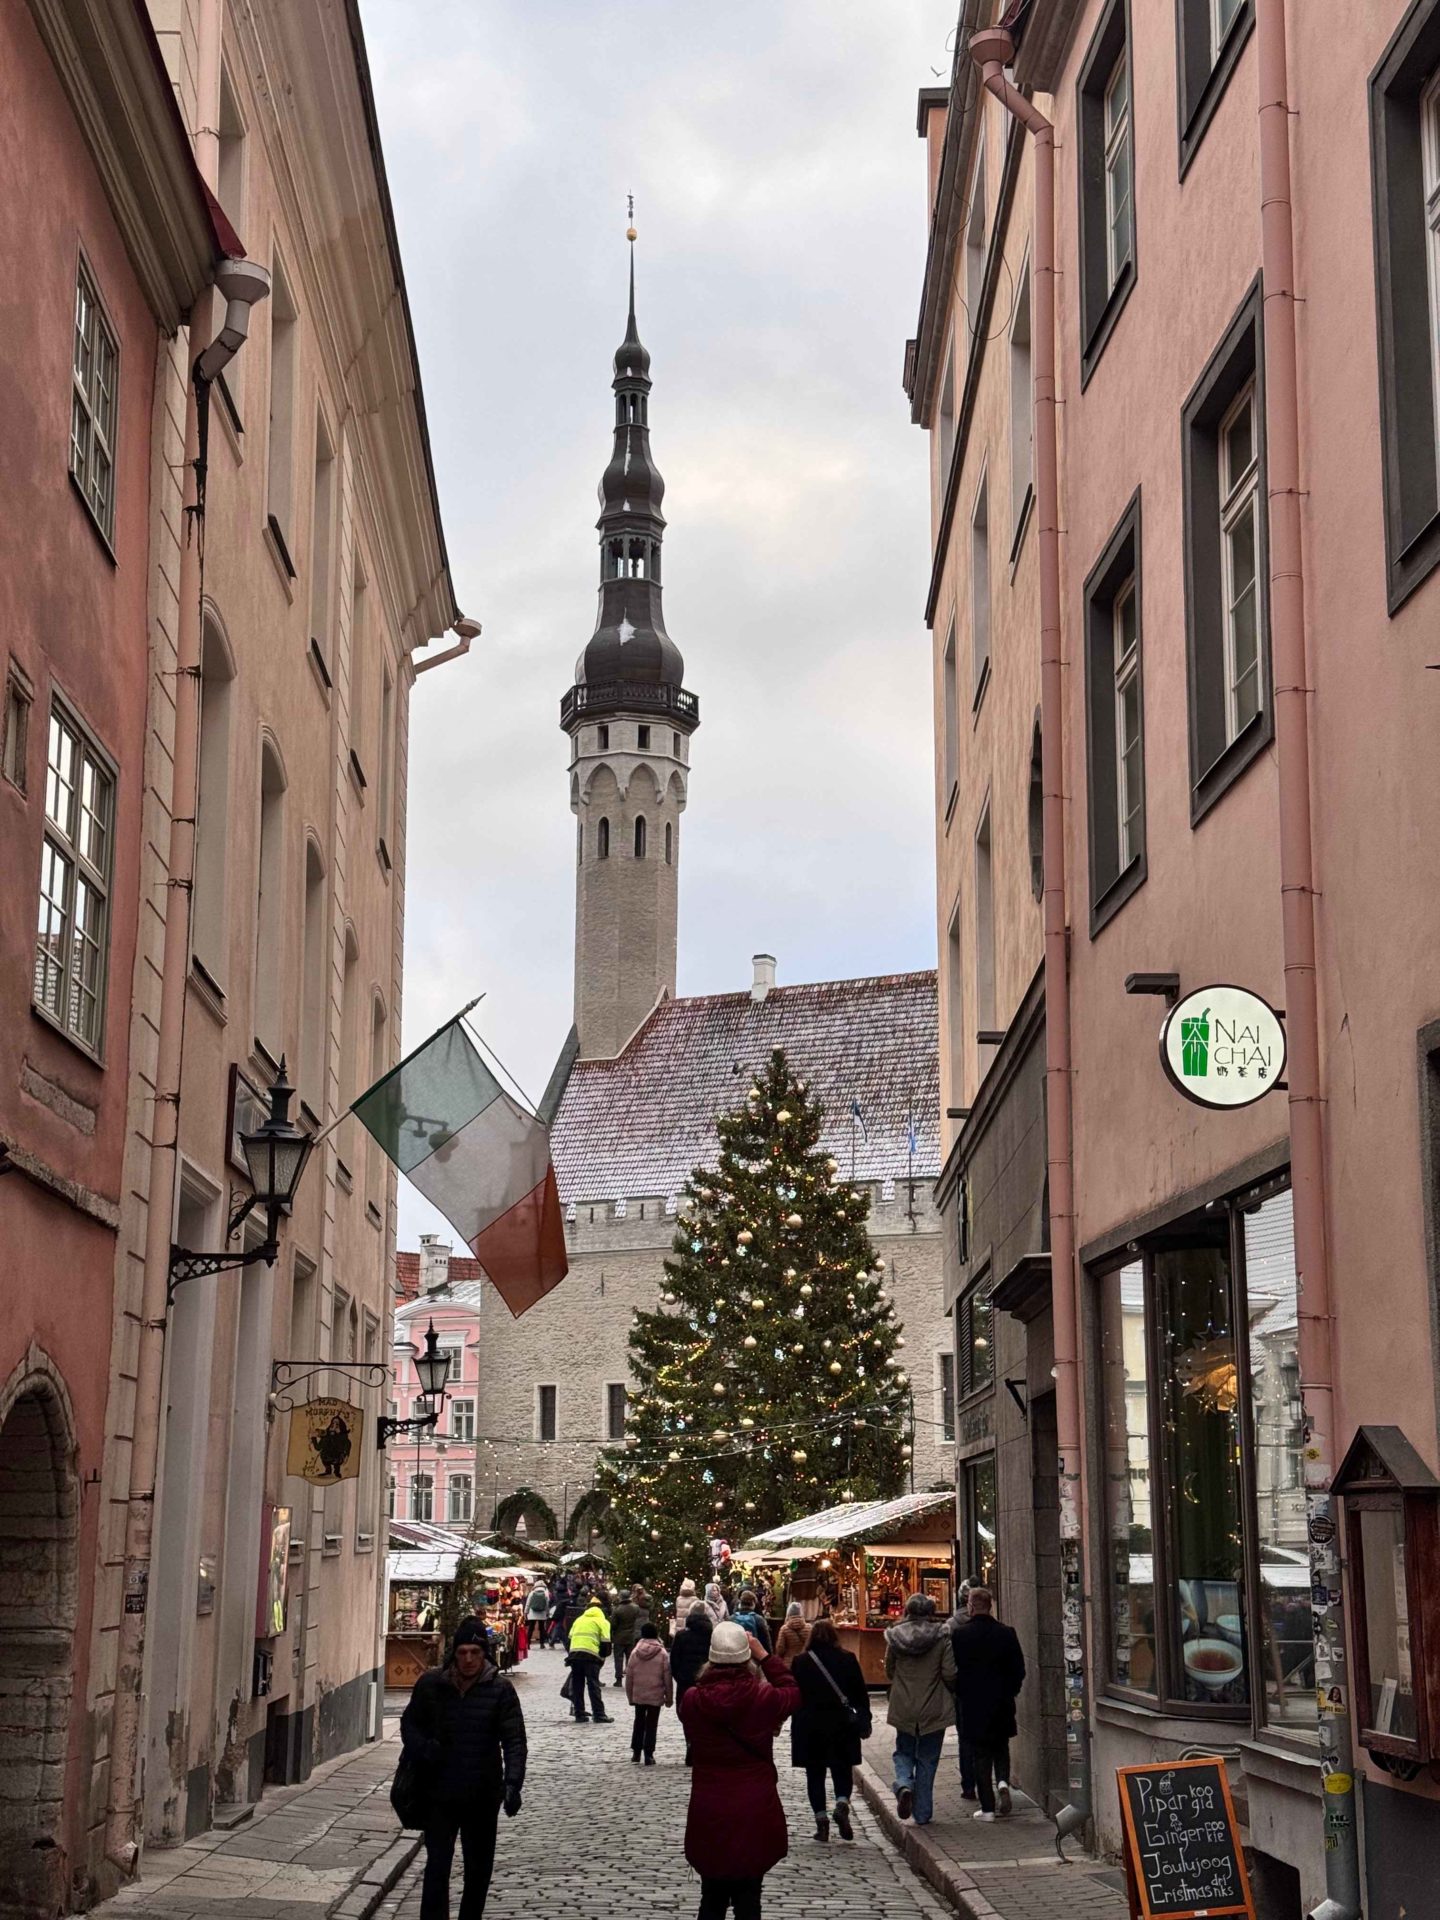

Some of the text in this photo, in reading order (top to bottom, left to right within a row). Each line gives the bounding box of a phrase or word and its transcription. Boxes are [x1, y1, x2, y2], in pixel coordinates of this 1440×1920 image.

[1216, 1019, 1260, 1044] NAI
[1214, 1046, 1271, 1067] CHAI
[318, 1398, 338, 1406] MAD
[1144, 1822, 1205, 1852] Ginger
[1150, 1878, 1213, 1904] Cristmas
